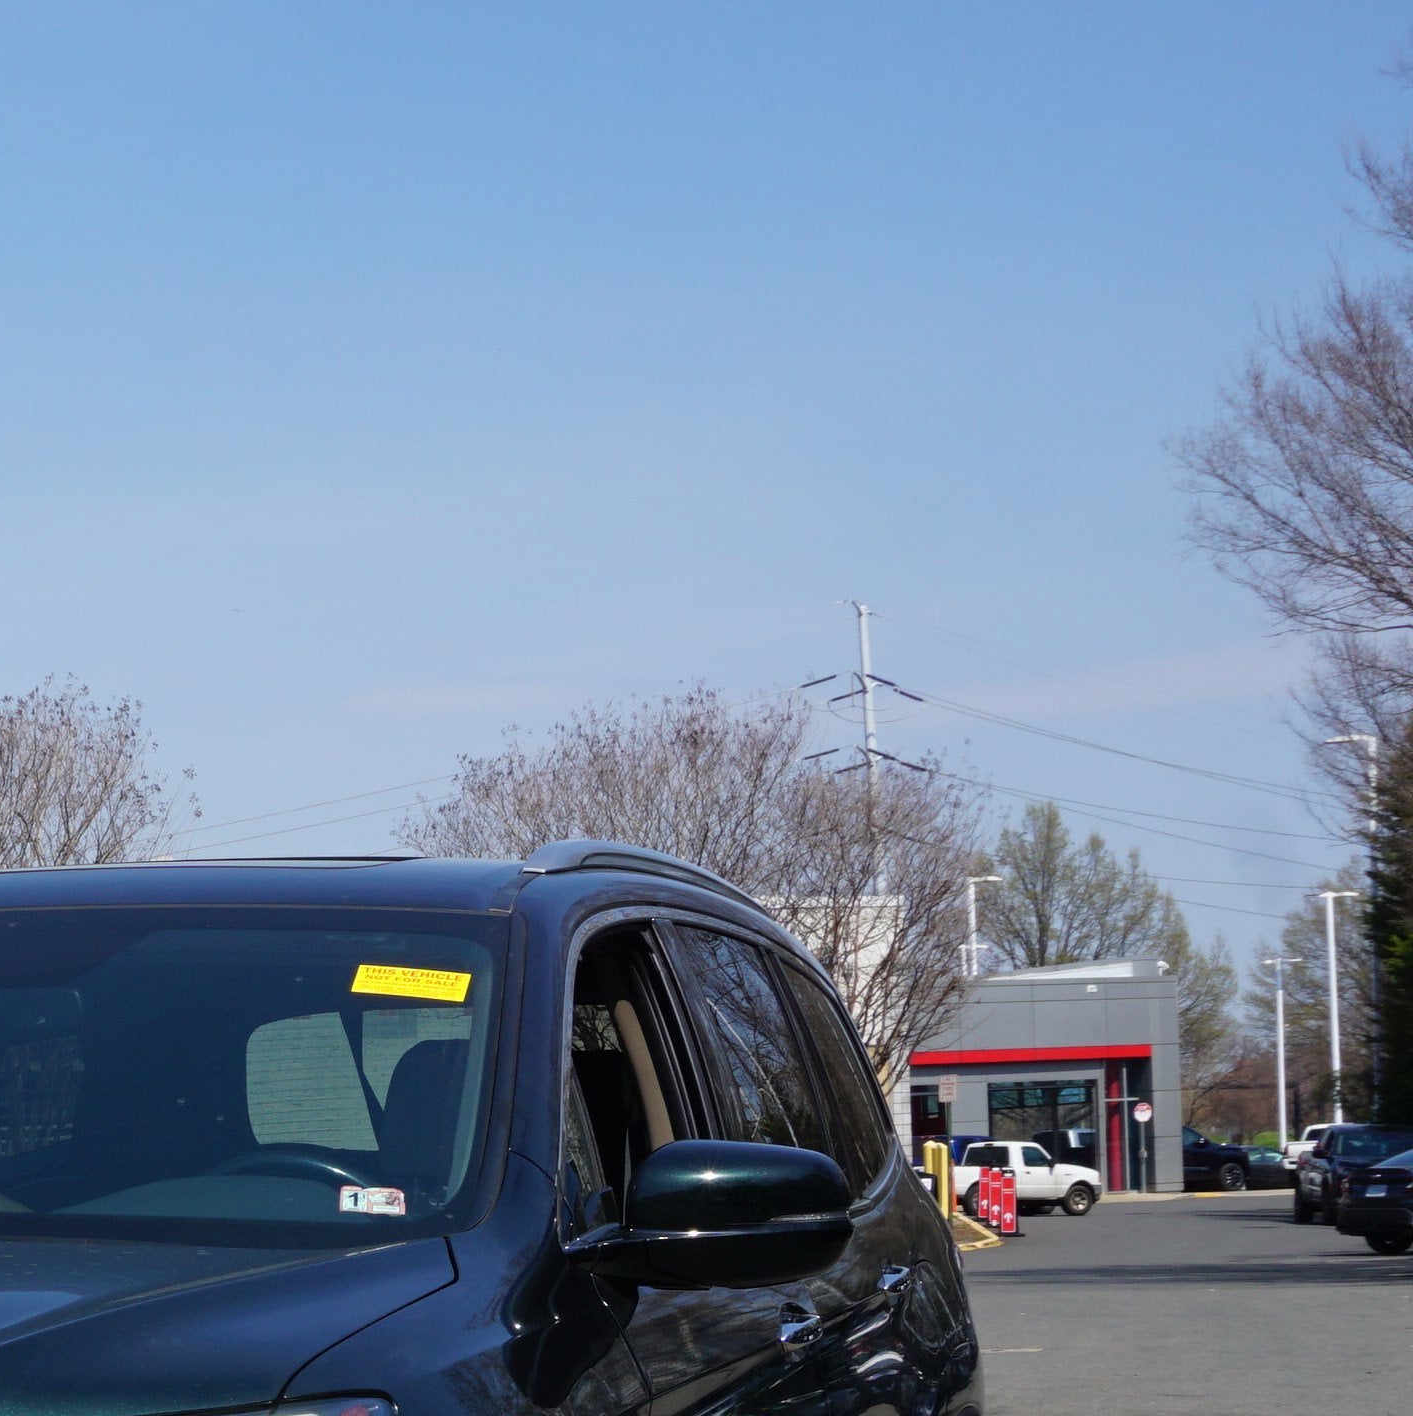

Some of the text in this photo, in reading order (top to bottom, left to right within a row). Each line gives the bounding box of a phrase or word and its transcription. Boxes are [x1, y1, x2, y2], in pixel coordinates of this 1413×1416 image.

[364, 966, 465, 981] THIS VEHICLE
[364, 974, 390, 982] NOT
[394, 976, 422, 984] FOR
[425, 979, 459, 988] SALE
